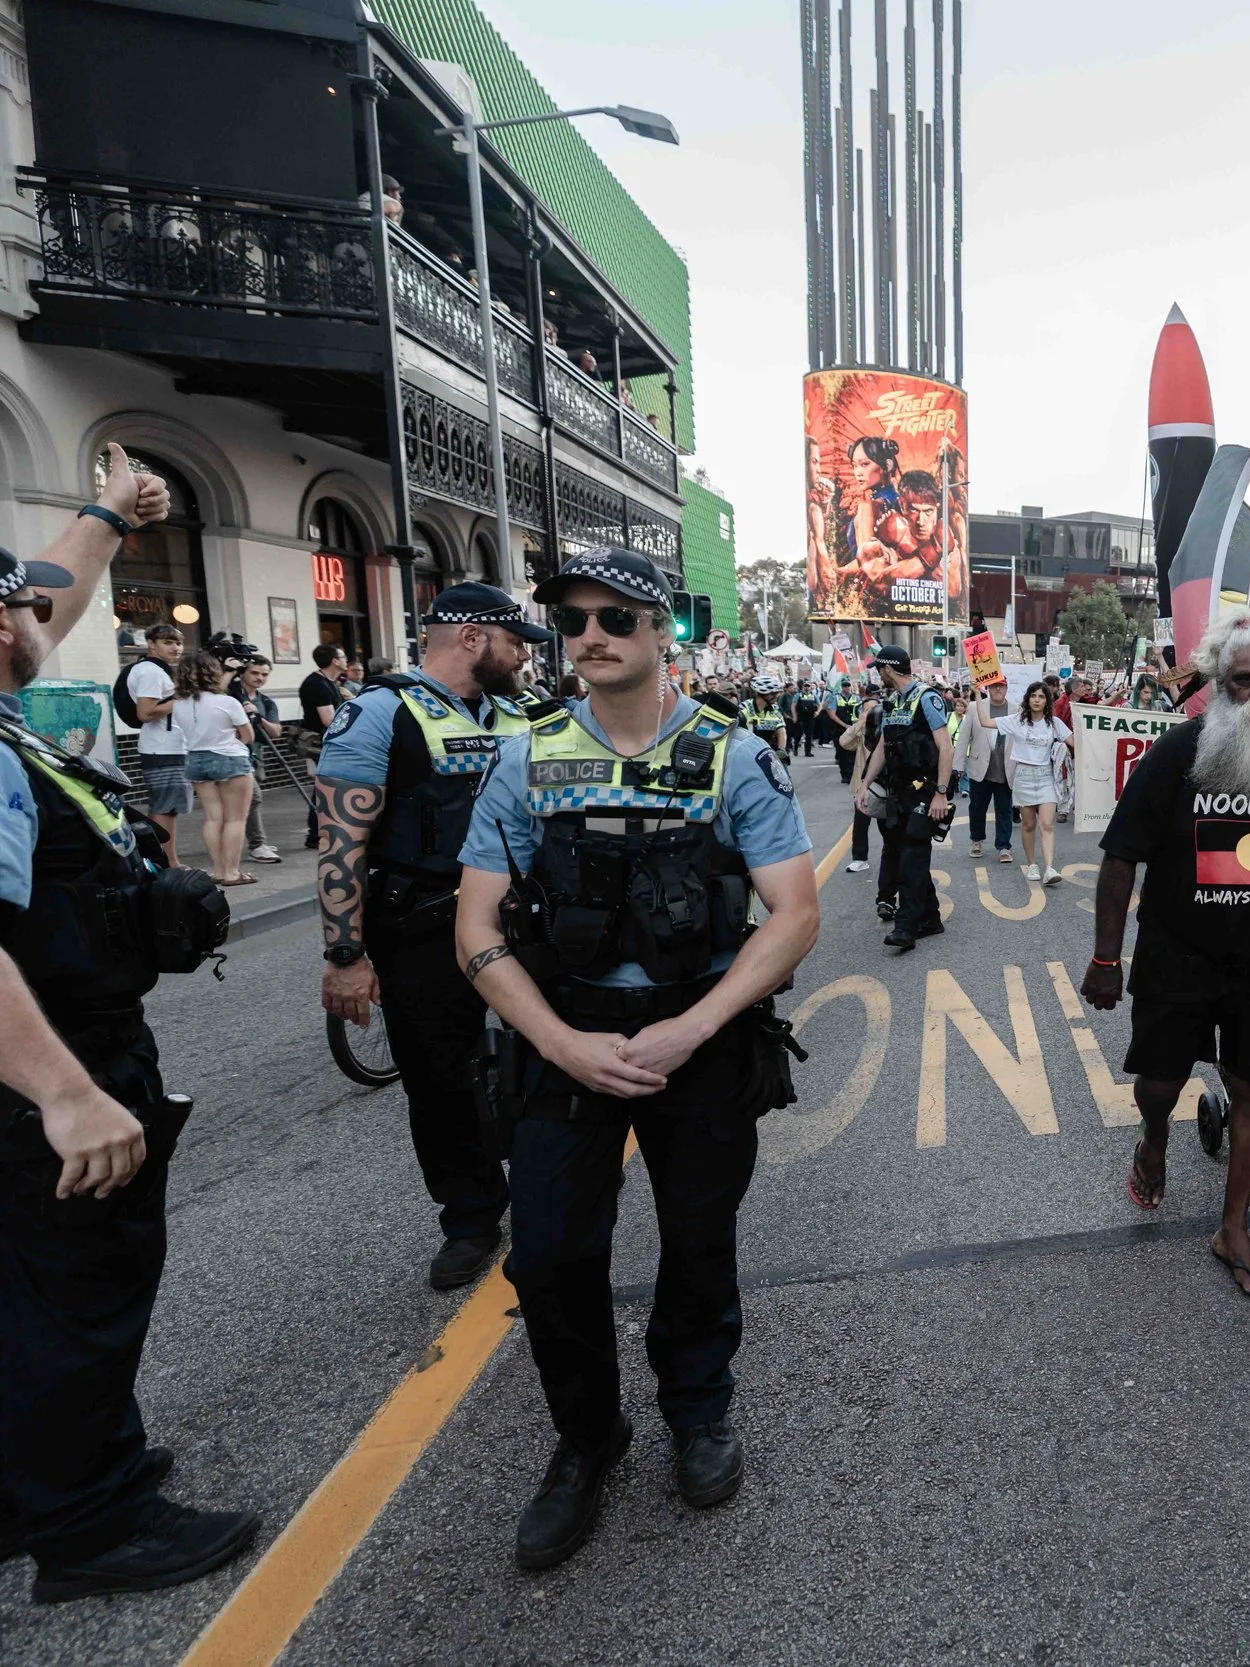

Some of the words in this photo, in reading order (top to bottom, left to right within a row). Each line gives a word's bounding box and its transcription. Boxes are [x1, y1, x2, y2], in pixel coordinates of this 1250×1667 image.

[865, 390, 945, 419] STREET
[878, 409, 958, 438] FIGHTER
[577, 556, 611, 564] POLICE
[896, 578, 919, 587] HITTING
[920, 580, 943, 589] CINEMAS
[891, 585, 936, 603] OCTOBER
[975, 671, 999, 683] AUKUS
[536, 761, 606, 782] POLICE
[1083, 813, 1101, 821] From
[1194, 889, 1250, 906] ALWAYS
[754, 961, 1210, 1163] ONL
